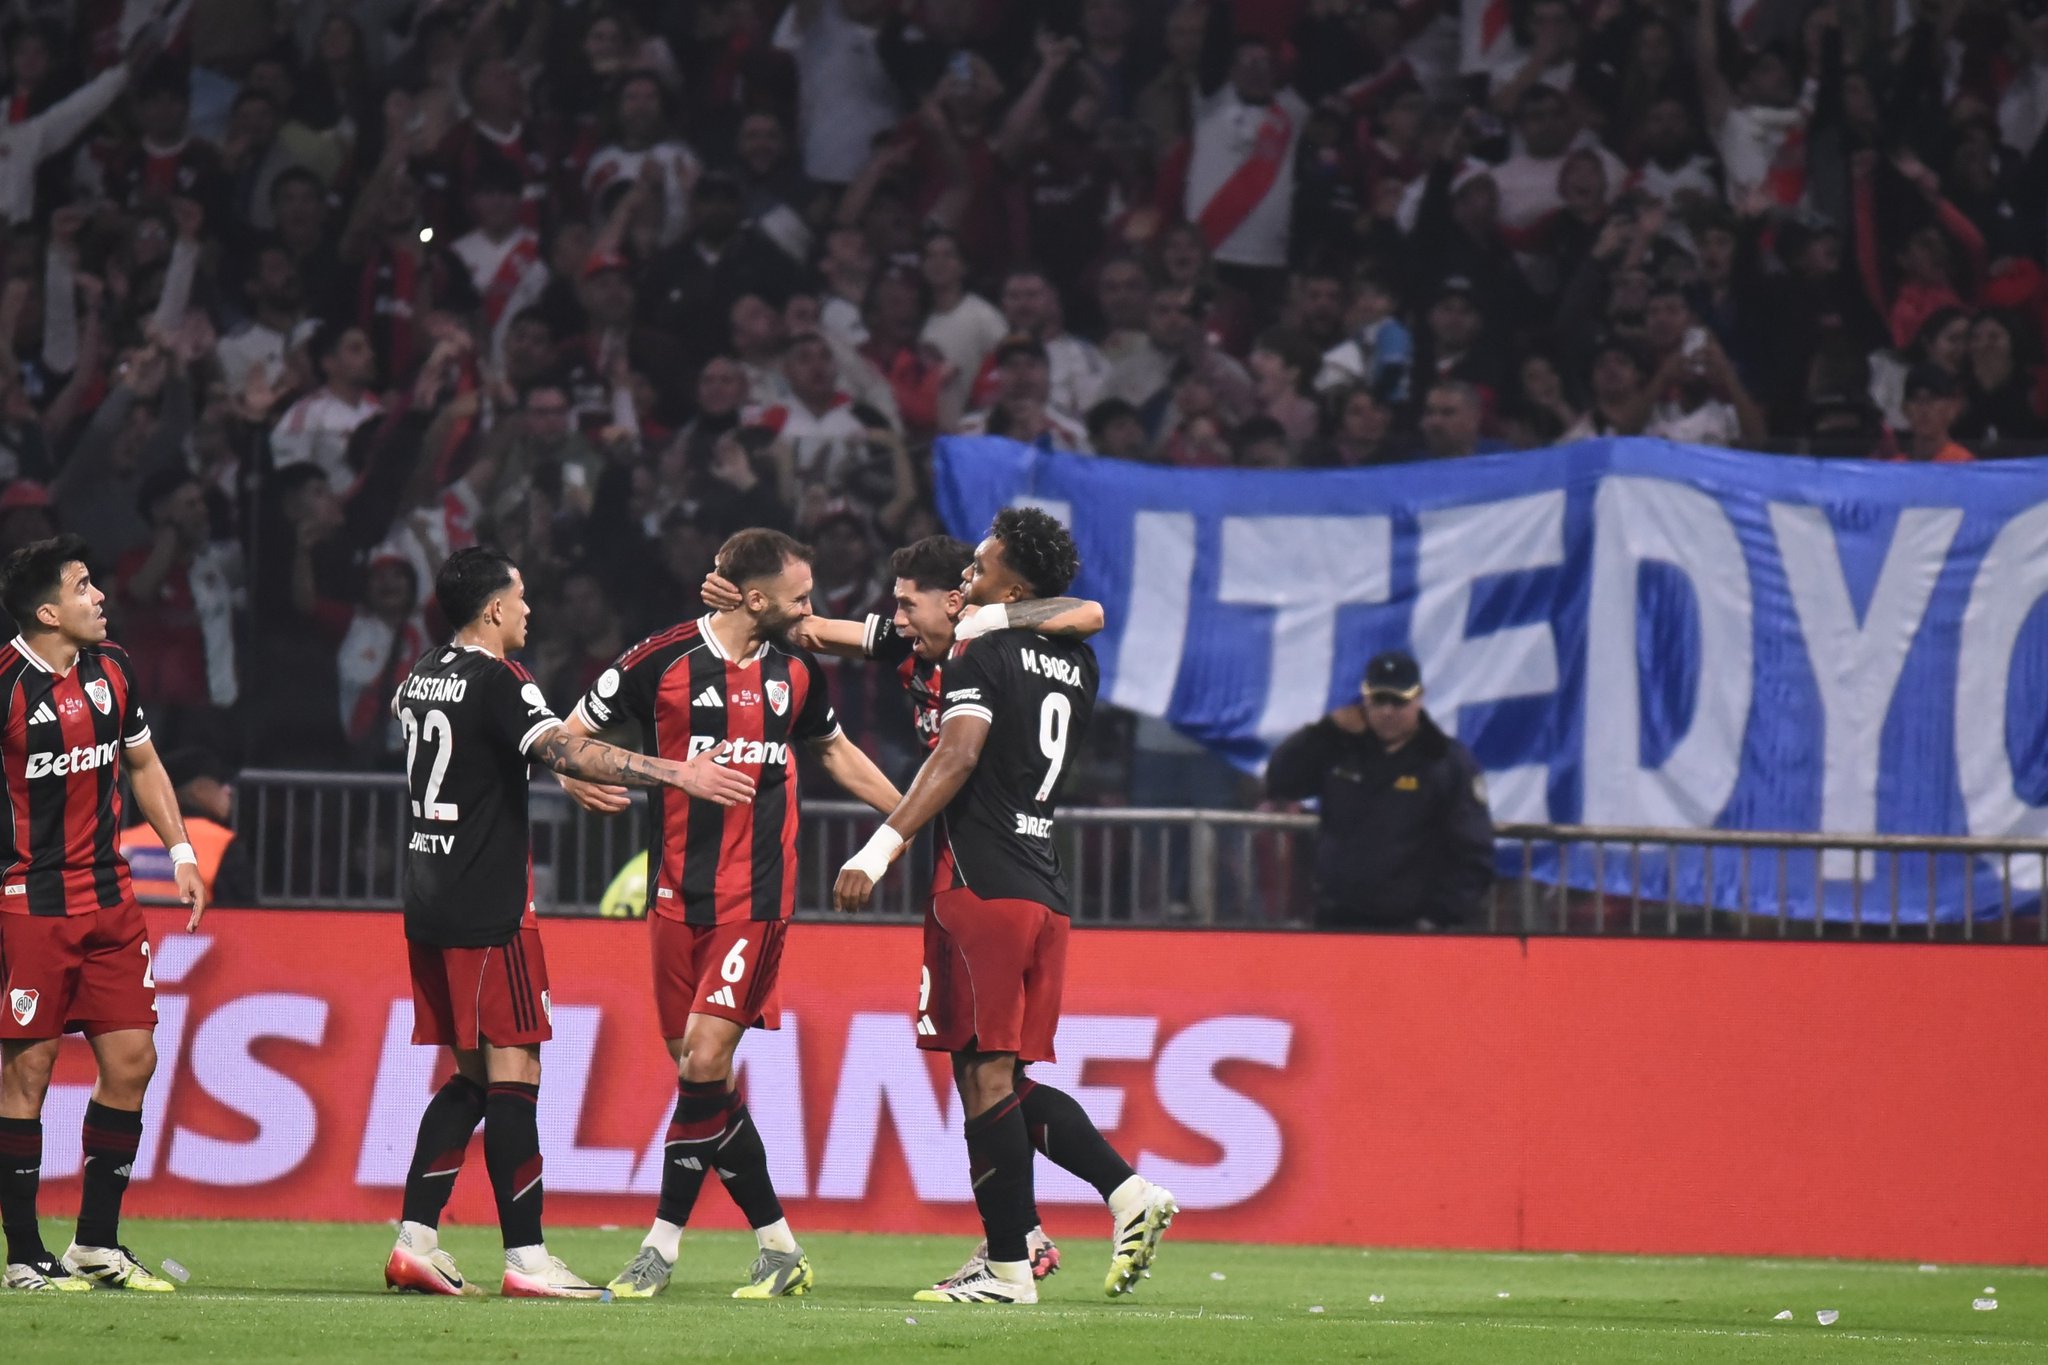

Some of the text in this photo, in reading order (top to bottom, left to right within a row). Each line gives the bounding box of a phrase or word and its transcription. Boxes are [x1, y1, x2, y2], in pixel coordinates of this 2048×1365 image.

[25, 739, 120, 779] Betano
[1035, 692, 1071, 802] 9
[720, 938, 749, 983] 6
